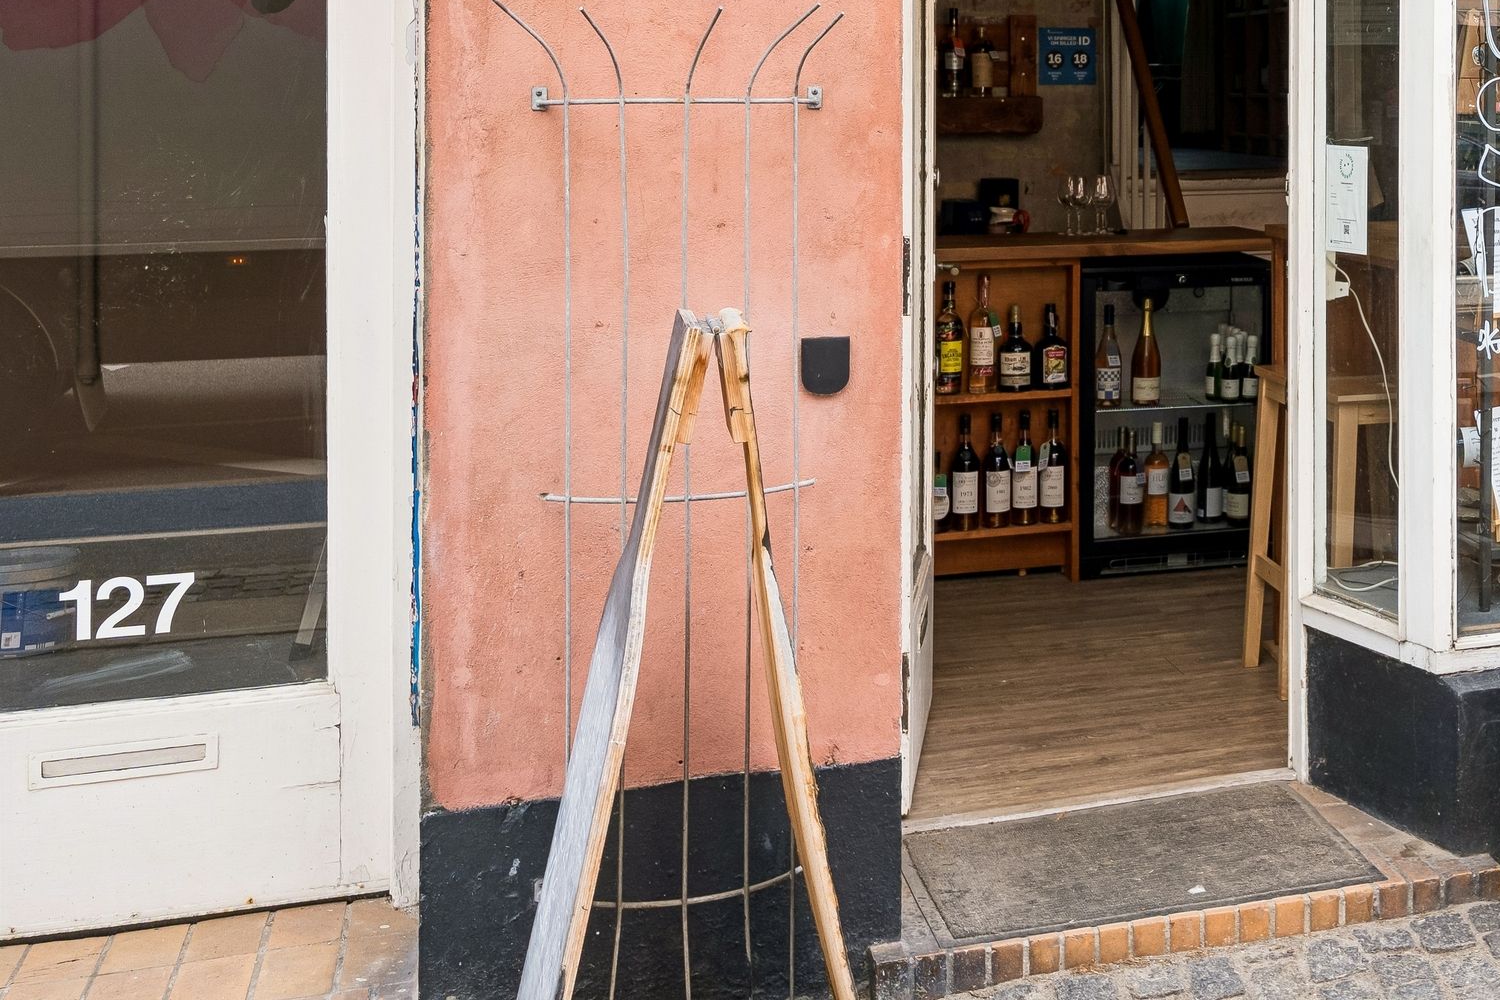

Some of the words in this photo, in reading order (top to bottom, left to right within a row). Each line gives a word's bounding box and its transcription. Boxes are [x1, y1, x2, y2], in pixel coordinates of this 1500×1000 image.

[1078, 35, 1091, 46] ID
[1047, 53, 1062, 64] 16
[1073, 53, 1088, 64] 18
[59, 571, 195, 641] 127
